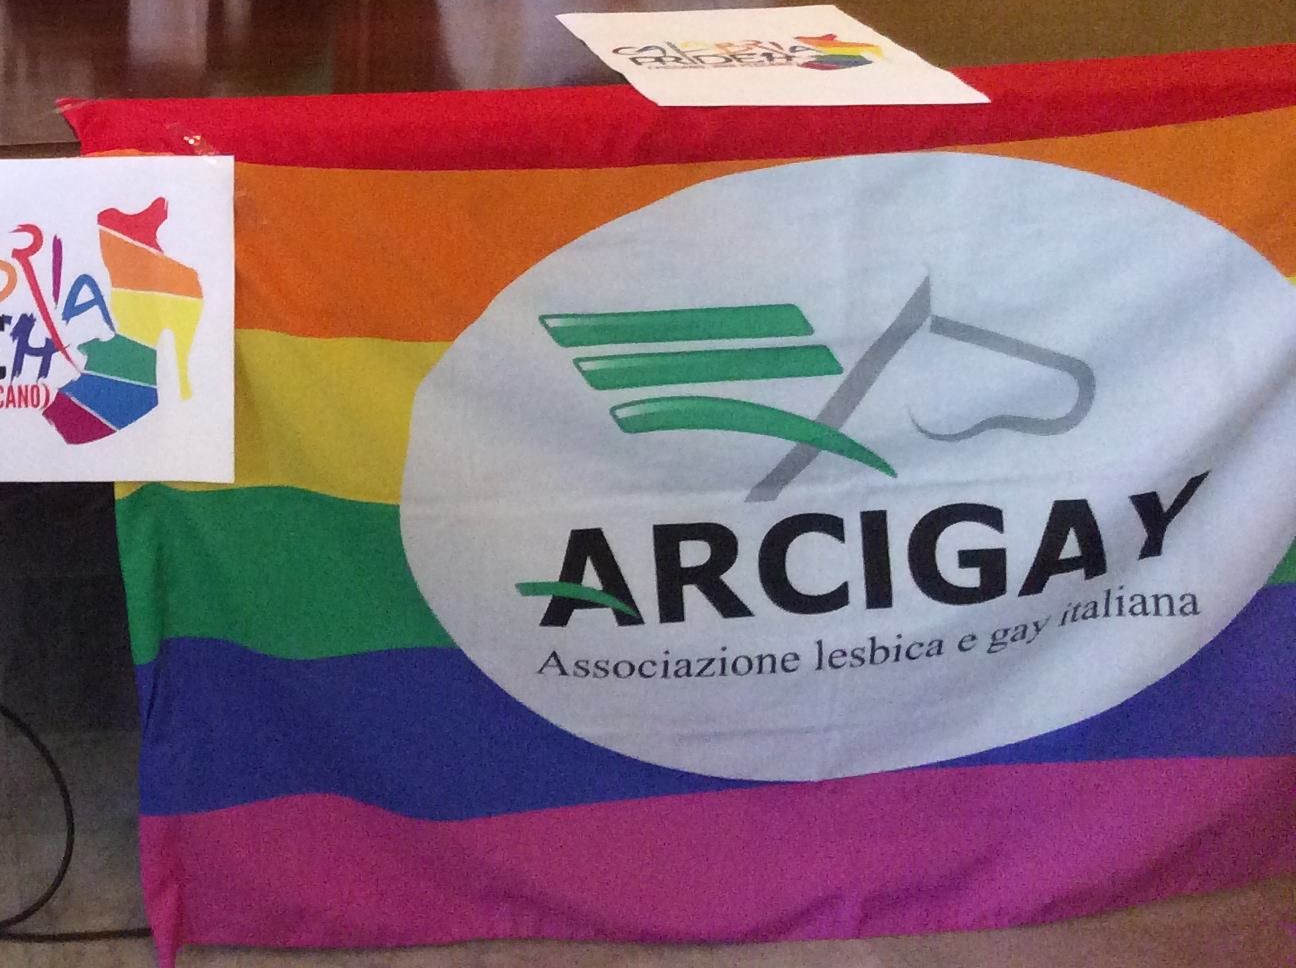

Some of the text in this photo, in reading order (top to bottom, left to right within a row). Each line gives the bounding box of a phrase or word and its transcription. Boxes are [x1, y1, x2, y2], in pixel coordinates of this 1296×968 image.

[515, 470, 1210, 629] ARCIGAY
[536, 583, 1202, 680] Associazione lesbica e gay italiana
